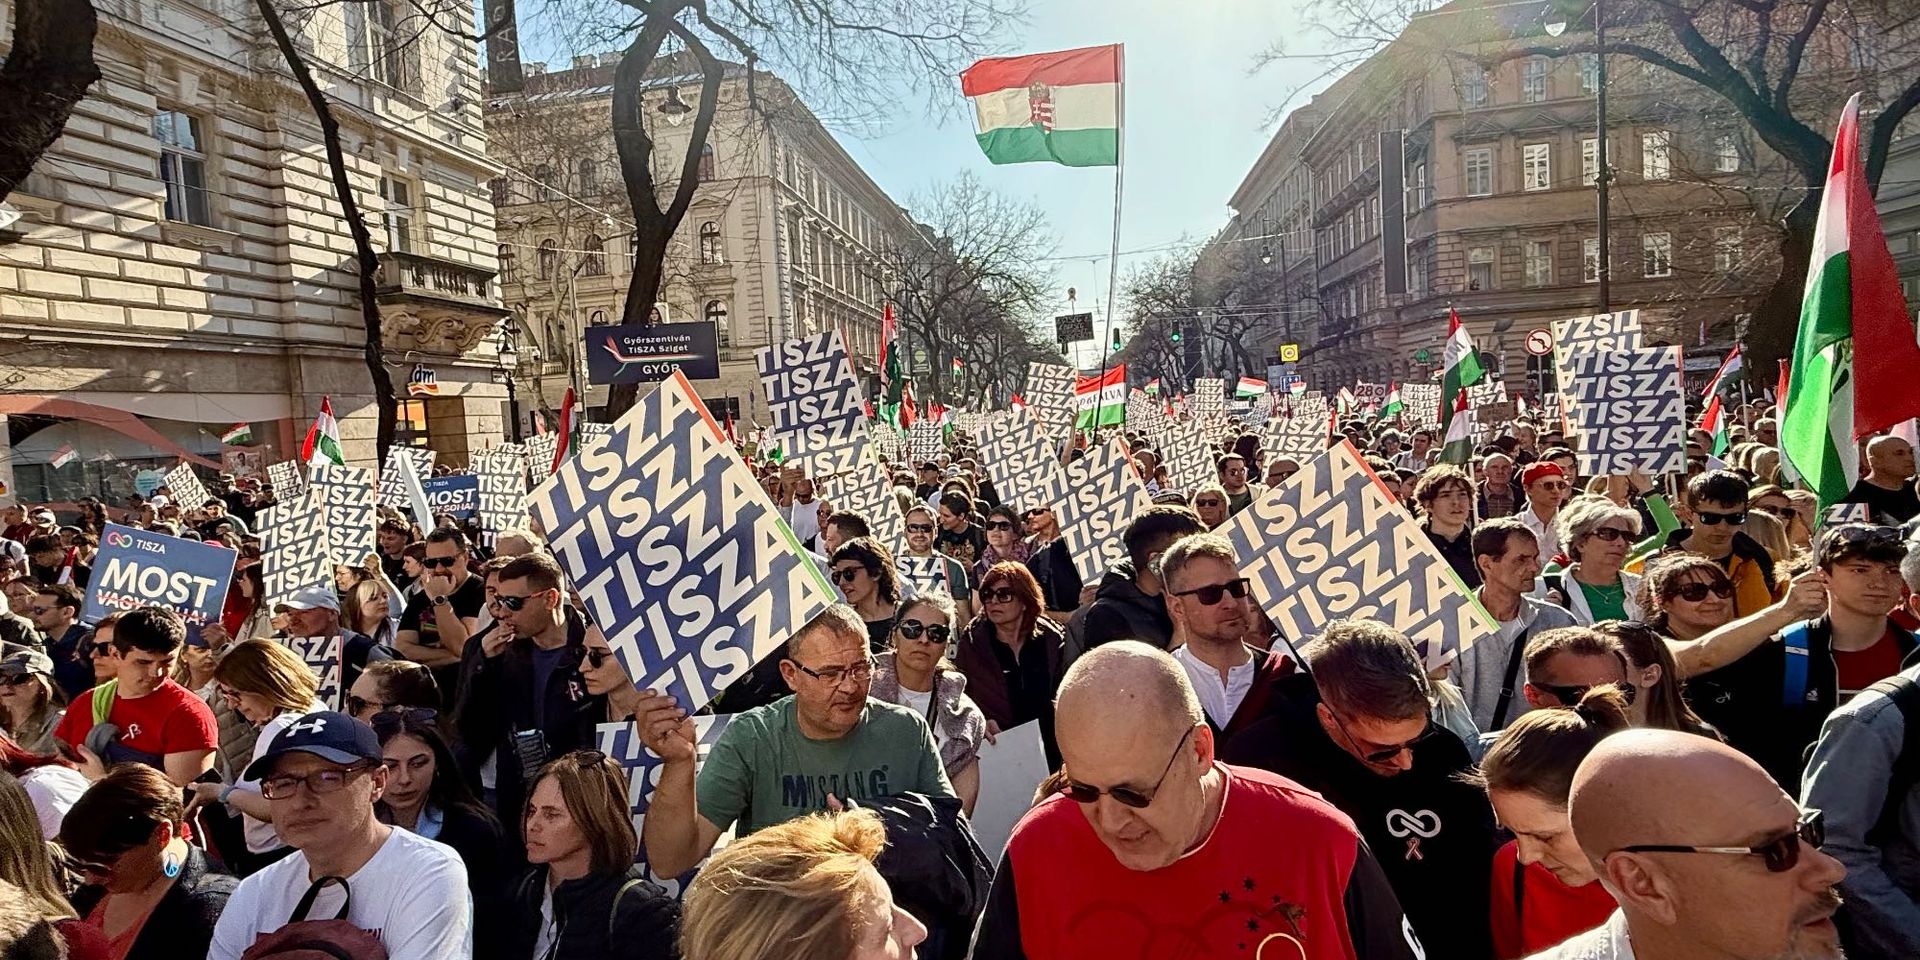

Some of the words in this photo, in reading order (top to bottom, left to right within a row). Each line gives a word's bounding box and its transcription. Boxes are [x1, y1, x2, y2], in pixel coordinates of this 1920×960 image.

[628, 345, 656, 354] TISZA
[658, 343, 689, 353] Sziget
[753, 329, 847, 373] TISZA
[1574, 346, 1679, 375] TISZA
[414, 366, 434, 384] dm
[760, 357, 855, 401] TISZA
[1027, 377, 1077, 396] TISZA
[1029, 362, 1078, 380] TISZA
[1575, 372, 1680, 399] TISZA
[1025, 391, 1077, 413] TISZA
[1357, 385, 1373, 396] 28
[768, 386, 863, 429] TISZA
[1576, 398, 1681, 426] TISZA
[525, 431, 556, 446] TISZA
[775, 414, 870, 458] TISZA
[972, 405, 1038, 446] TISZA
[1156, 418, 1205, 448] TISZA
[1267, 416, 1328, 435] TISZA
[1576, 425, 1683, 451] TISZA
[527, 374, 700, 535] TISZA
[979, 423, 1046, 465] TISZA
[1160, 431, 1209, 462] TISZA
[1265, 435, 1327, 453] TISZA
[270, 470, 301, 483] TISZA
[309, 463, 374, 486] TISZA
[476, 456, 524, 475] TISZA
[986, 441, 1055, 482] TISZA
[1039, 435, 1129, 501] TISZA
[1164, 444, 1214, 478] TISZA
[1168, 458, 1218, 489] TISZA
[1576, 451, 1684, 477] TISZA
[477, 475, 526, 493] TISZA
[822, 462, 888, 499] TISZA
[1050, 463, 1141, 528] TISZA
[255, 489, 324, 530] TISZA
[376, 494, 411, 507] TISZ
[479, 493, 529, 513] TISZA
[551, 417, 731, 583] TISZA
[257, 512, 327, 552] TISZA
[480, 512, 531, 531] TISZA
[136, 540, 166, 554] TISZA
[260, 534, 330, 575] TISZA
[577, 462, 762, 632] TISZA
[1072, 536, 1124, 580] TIS
[1239, 481, 1401, 606] TISZA
[263, 557, 332, 597] TISZA
[896, 556, 945, 577] SZA
[100, 558, 217, 608] MOST
[611, 509, 798, 683] TISZA
[1265, 521, 1434, 644] TISZA
[645, 560, 833, 711] TISZA
[782, 769, 888, 808] MUSTANG
